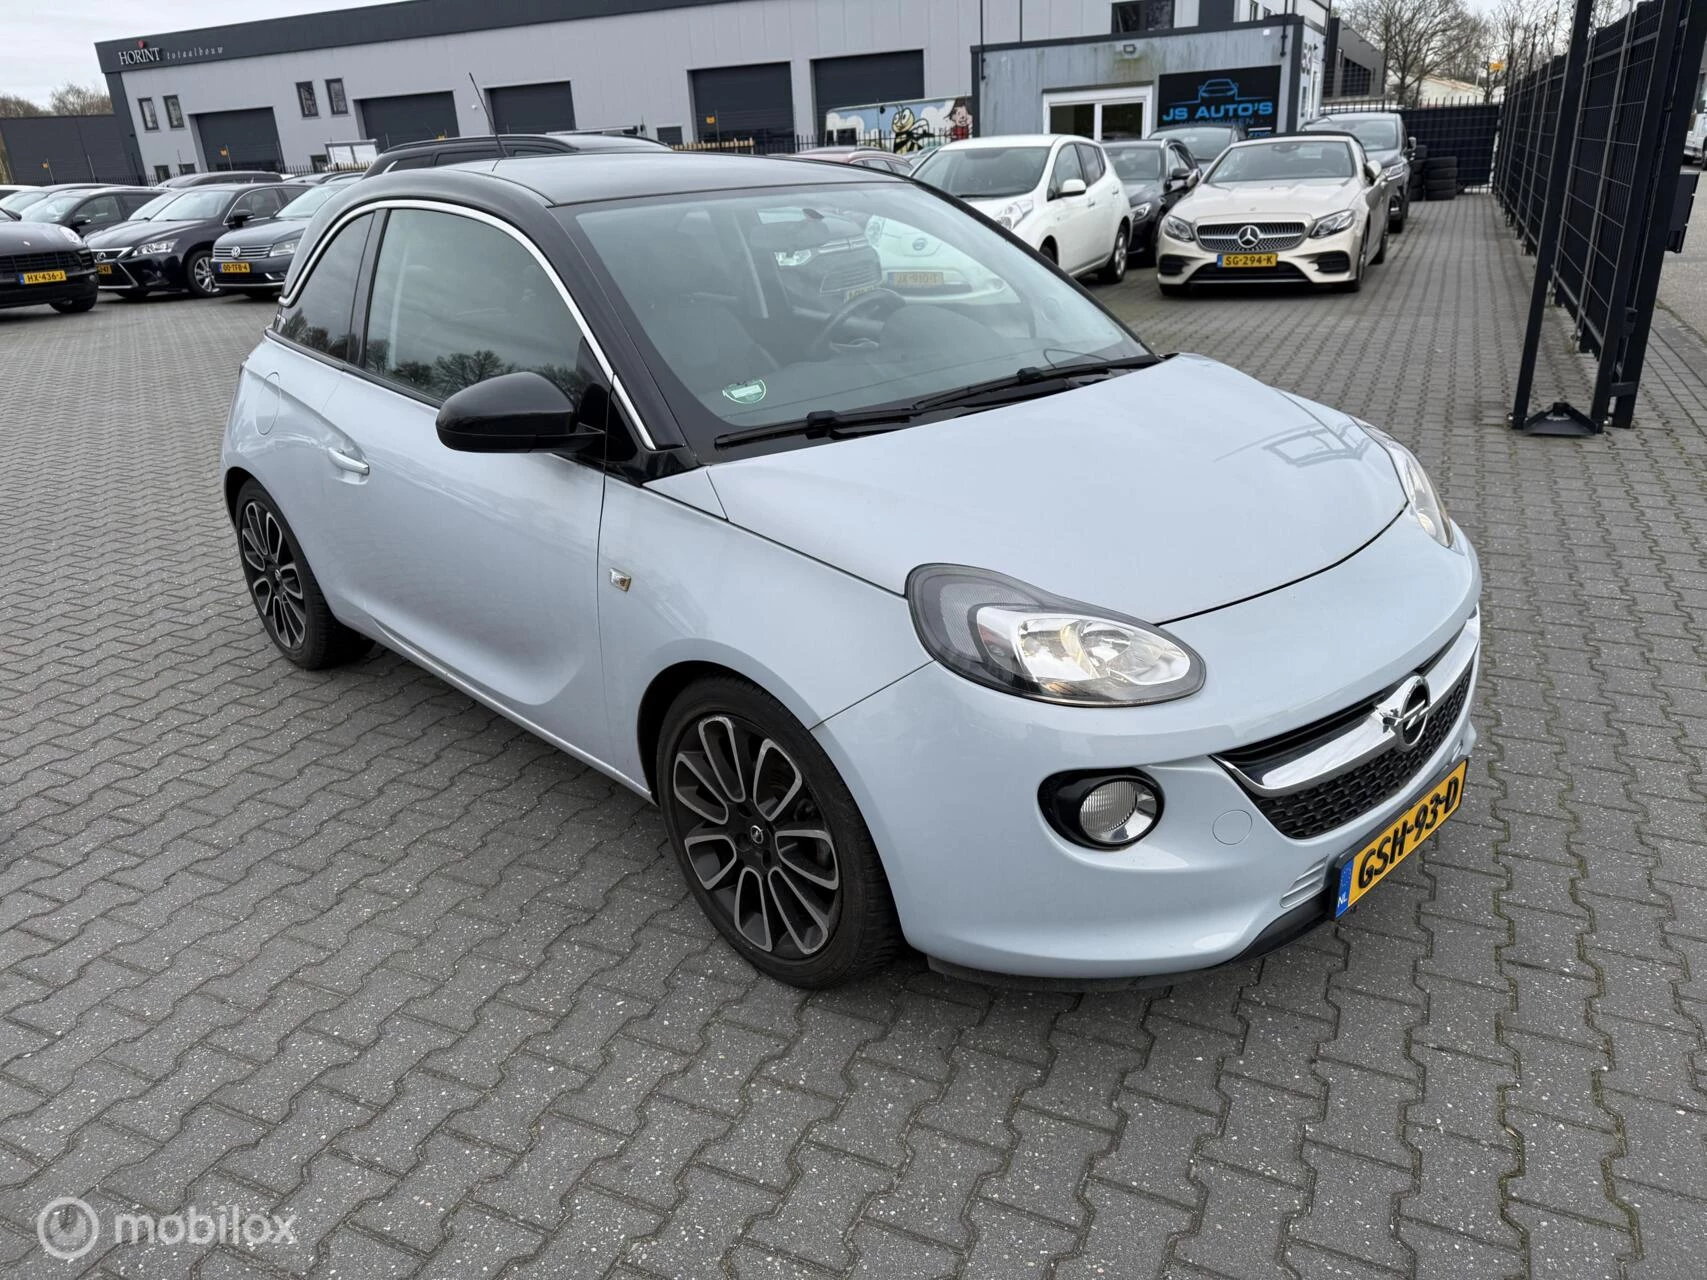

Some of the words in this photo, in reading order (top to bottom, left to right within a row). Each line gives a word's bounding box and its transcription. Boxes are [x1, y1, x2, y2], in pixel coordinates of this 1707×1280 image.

[118, 47, 160, 65] HORINT
[166, 46, 224, 60] totaalbouw
[1162, 107, 1189, 121] JS
[1195, 101, 1274, 120] AUTO'S
[1224, 255, 1274, 266] SG-294-K
[26, 271, 65, 283] HX-436-J
[1358, 775, 1460, 889] GSH-93-D
